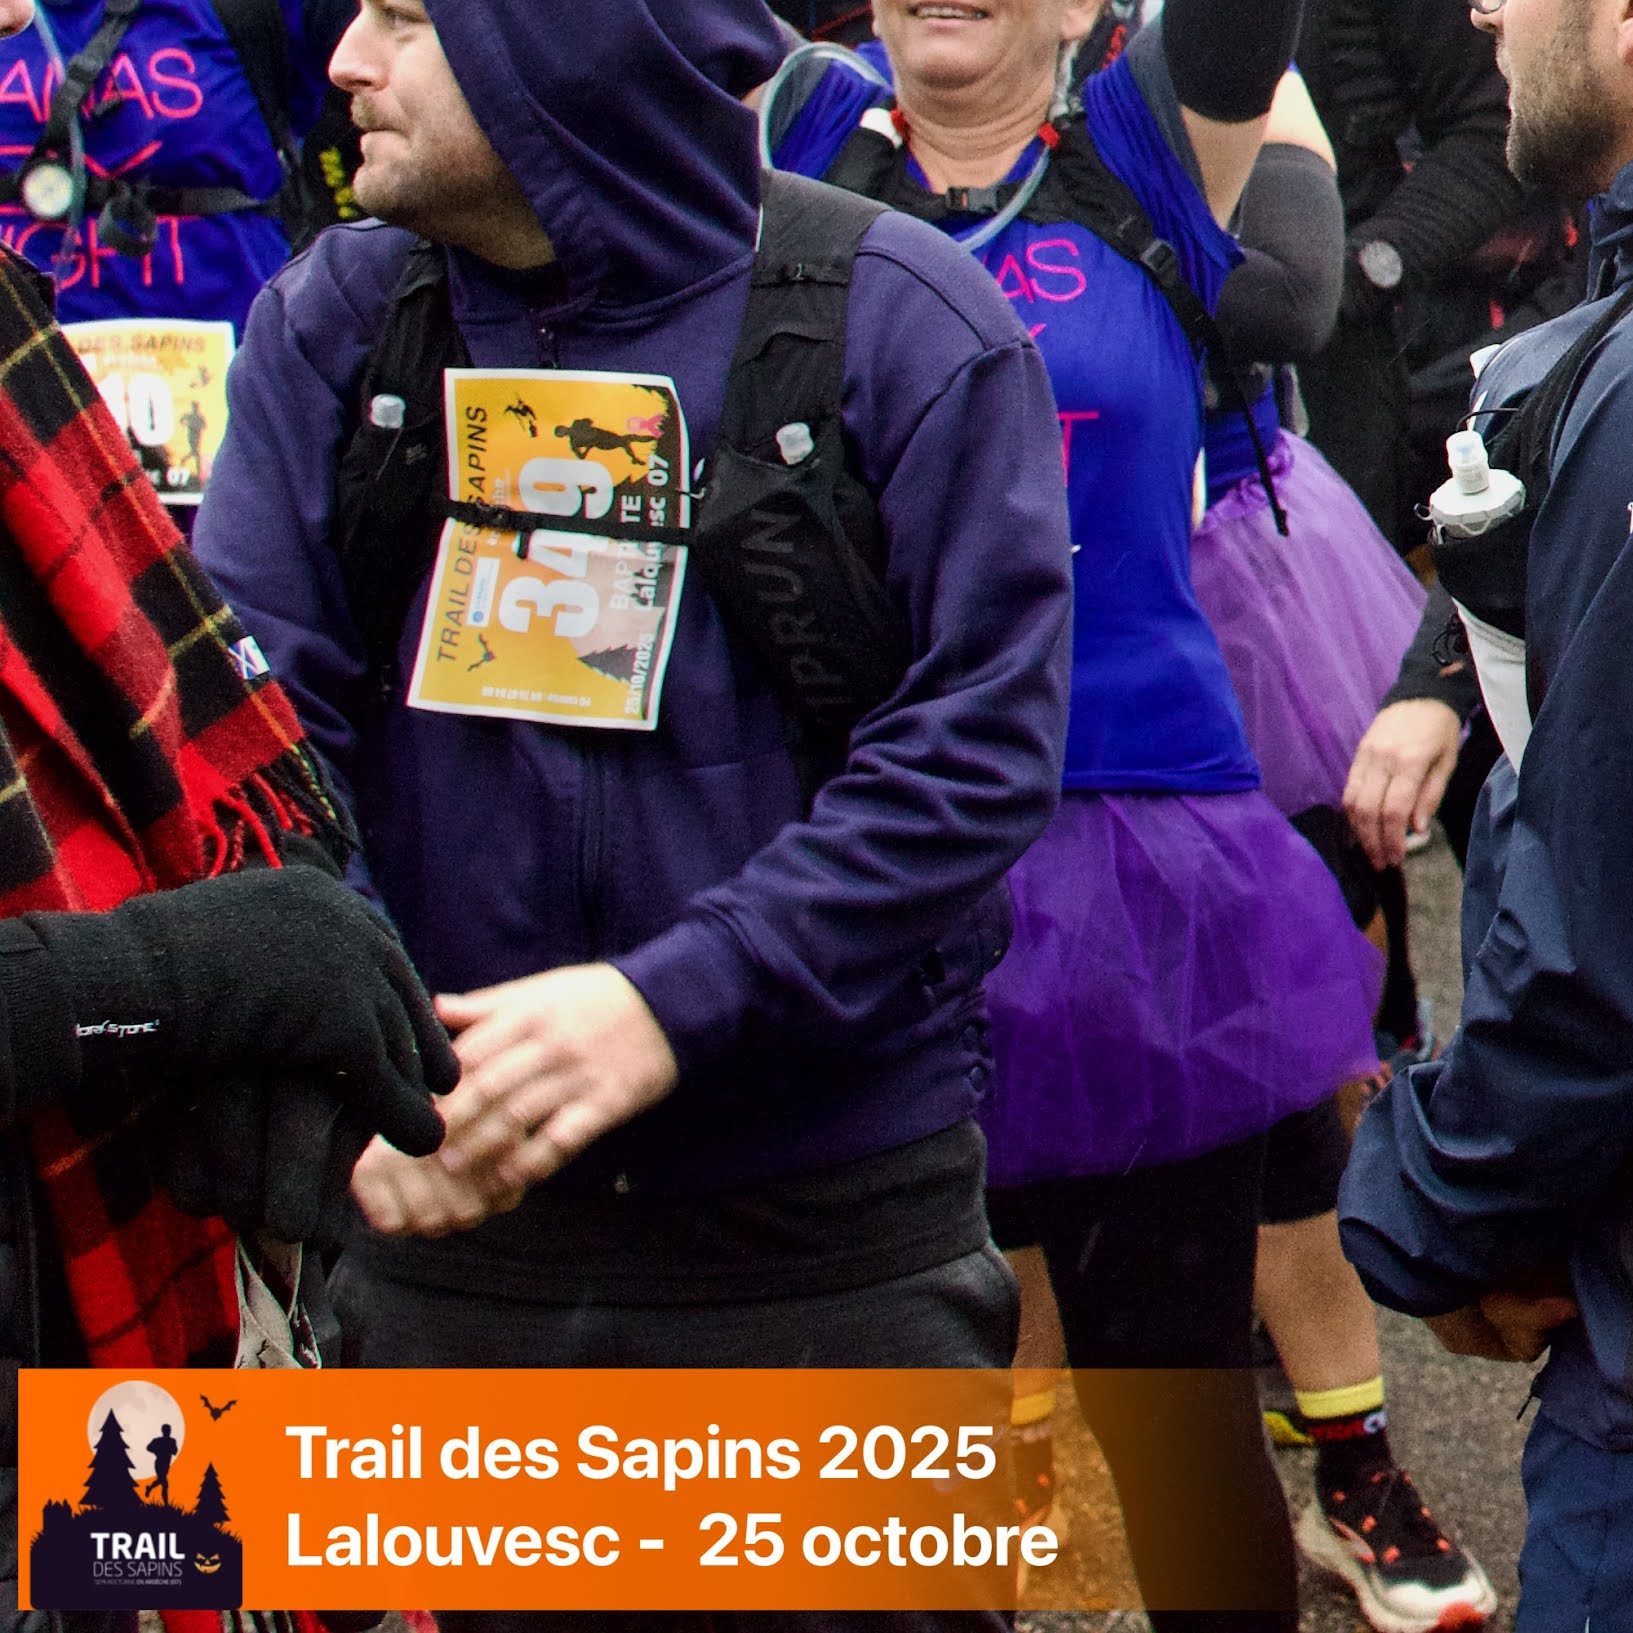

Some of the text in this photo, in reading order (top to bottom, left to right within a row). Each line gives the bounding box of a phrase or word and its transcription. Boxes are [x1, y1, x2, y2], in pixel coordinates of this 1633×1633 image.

[647, 454, 670, 487] 07
[453, 522, 481, 576] DES
[499, 455, 615, 638] 349
[437, 583, 470, 663] TRAIL
